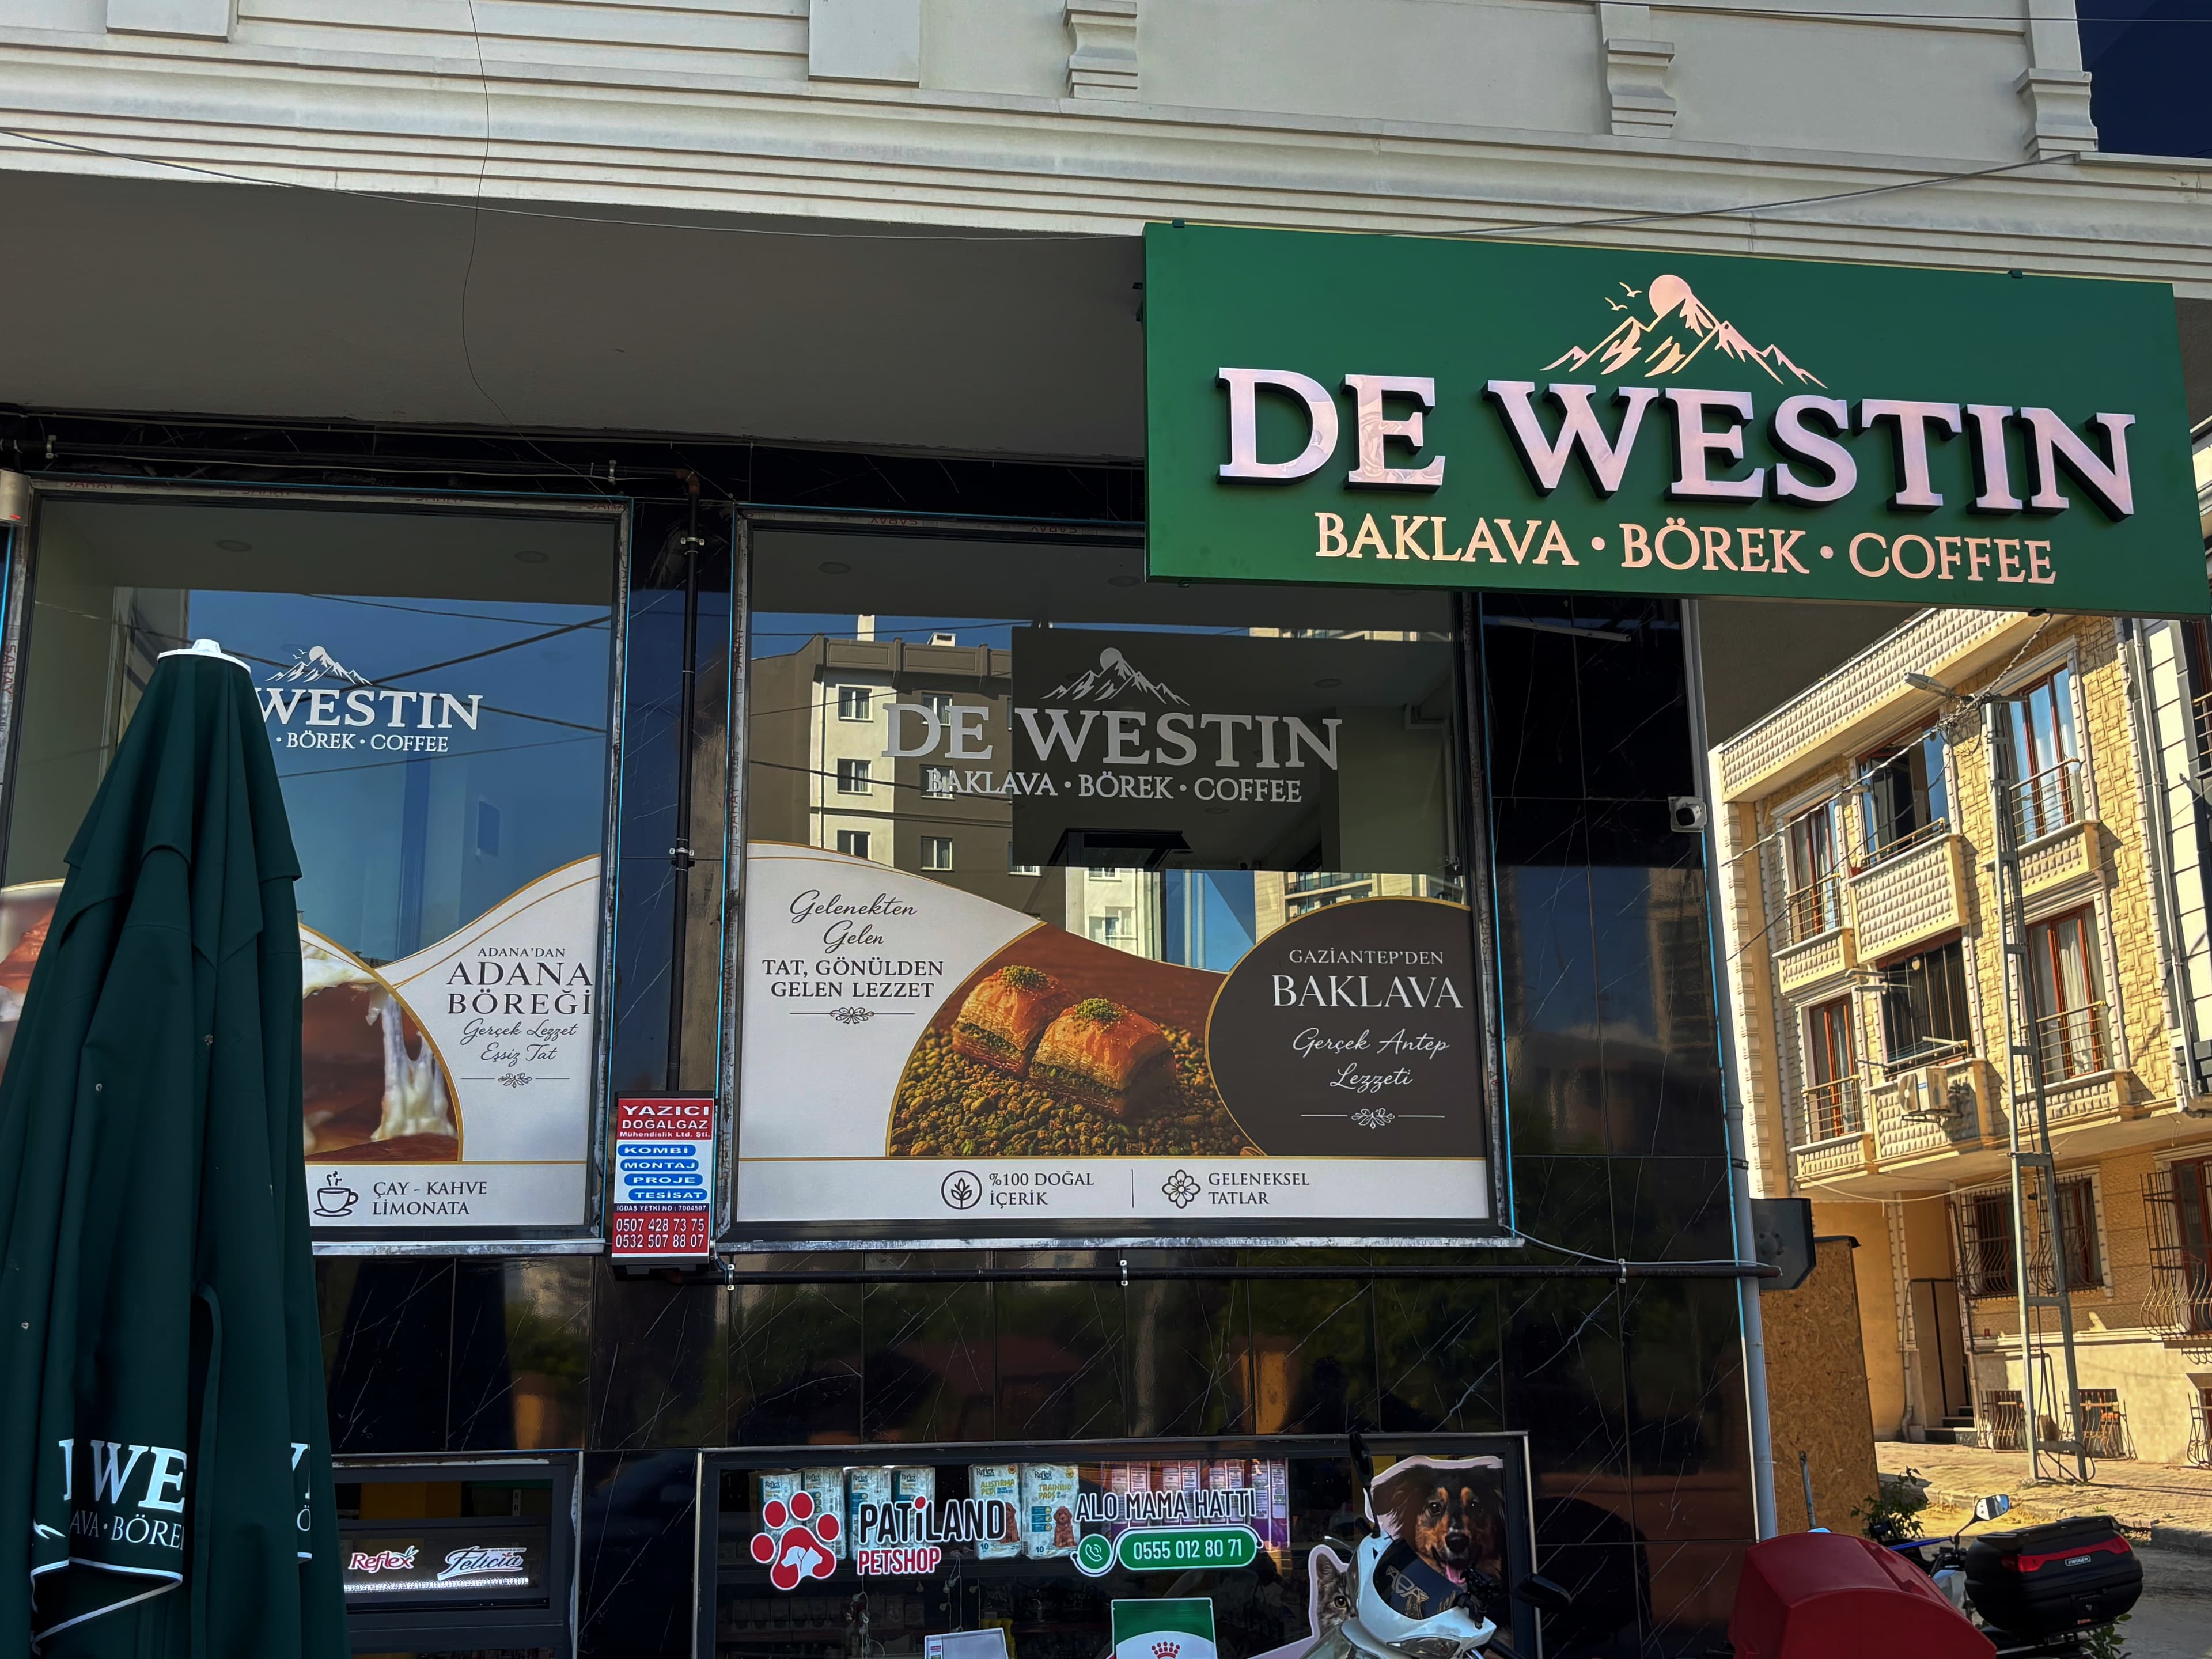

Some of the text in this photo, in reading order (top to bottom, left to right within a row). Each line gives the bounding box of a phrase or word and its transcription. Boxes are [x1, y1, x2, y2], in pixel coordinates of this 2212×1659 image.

[1215, 366, 2135, 522] DE WESTIN
[1315, 512, 2056, 585] BAKLAVA BÖREK COFFEE
[255, 687, 483, 730] WESTIN
[286, 730, 449, 752] BÖREK COFFEE
[882, 703, 1343, 770] DE WESTIN
[927, 769, 1302, 803] BAKLAVA BÖREK COFFEE
[789, 889, 918, 924] Gelenekten
[823, 919, 884, 954] Gelen
[478, 947, 566, 958] ADANA'DAN
[1289, 947, 1444, 965] GAZİANTEP'DEN
[446, 961, 594, 986] ADANA
[762, 957, 944, 978] TAT, GÖNÜLDEN
[447, 988, 592, 1015] BÖREĞİ
[771, 981, 935, 998] GELEN LEZZET
[1272, 974, 1464, 1009] BAKLAVA
[460, 1018, 578, 1045] Gerçek Lezzet
[1293, 1028, 1450, 1059] Gerçek Antep
[480, 1042, 558, 1067] Eşsiz Tat
[1330, 1062, 1413, 1093] Lezzeti
[622, 1105, 709, 1116] YAZICI
[622, 1117, 708, 1130] DOĞALGAZ
[373, 1181, 408, 1198] ÇAY
[427, 1181, 487, 1195] KAHVE
[988, 1170, 1094, 1187] %100 DOĞAL
[1208, 1172, 1310, 1187] GELENEKSEL
[372, 1199, 470, 1215] LİMONATA
[635, 1190, 703, 1199] TESİSAT
[989, 1191, 1048, 1208] İÇERİK
[1208, 1191, 1270, 1205] TATLAR
[616, 1218, 704, 1232] 0507 428 73 75
[616, 1234, 704, 1248] 0532 507 88 07
[1075, 1493, 1118, 1522] ALO
[1126, 1490, 1188, 1521] MAMA
[1194, 1488, 1256, 1518] HATTI
[111, 1514, 184, 1551] BÖRE
[858, 1547, 940, 1575] PETSHOP
[1133, 1539, 1242, 1560] 0555 012 80 71
[349, 1547, 524, 1579] Reflex Felicia
